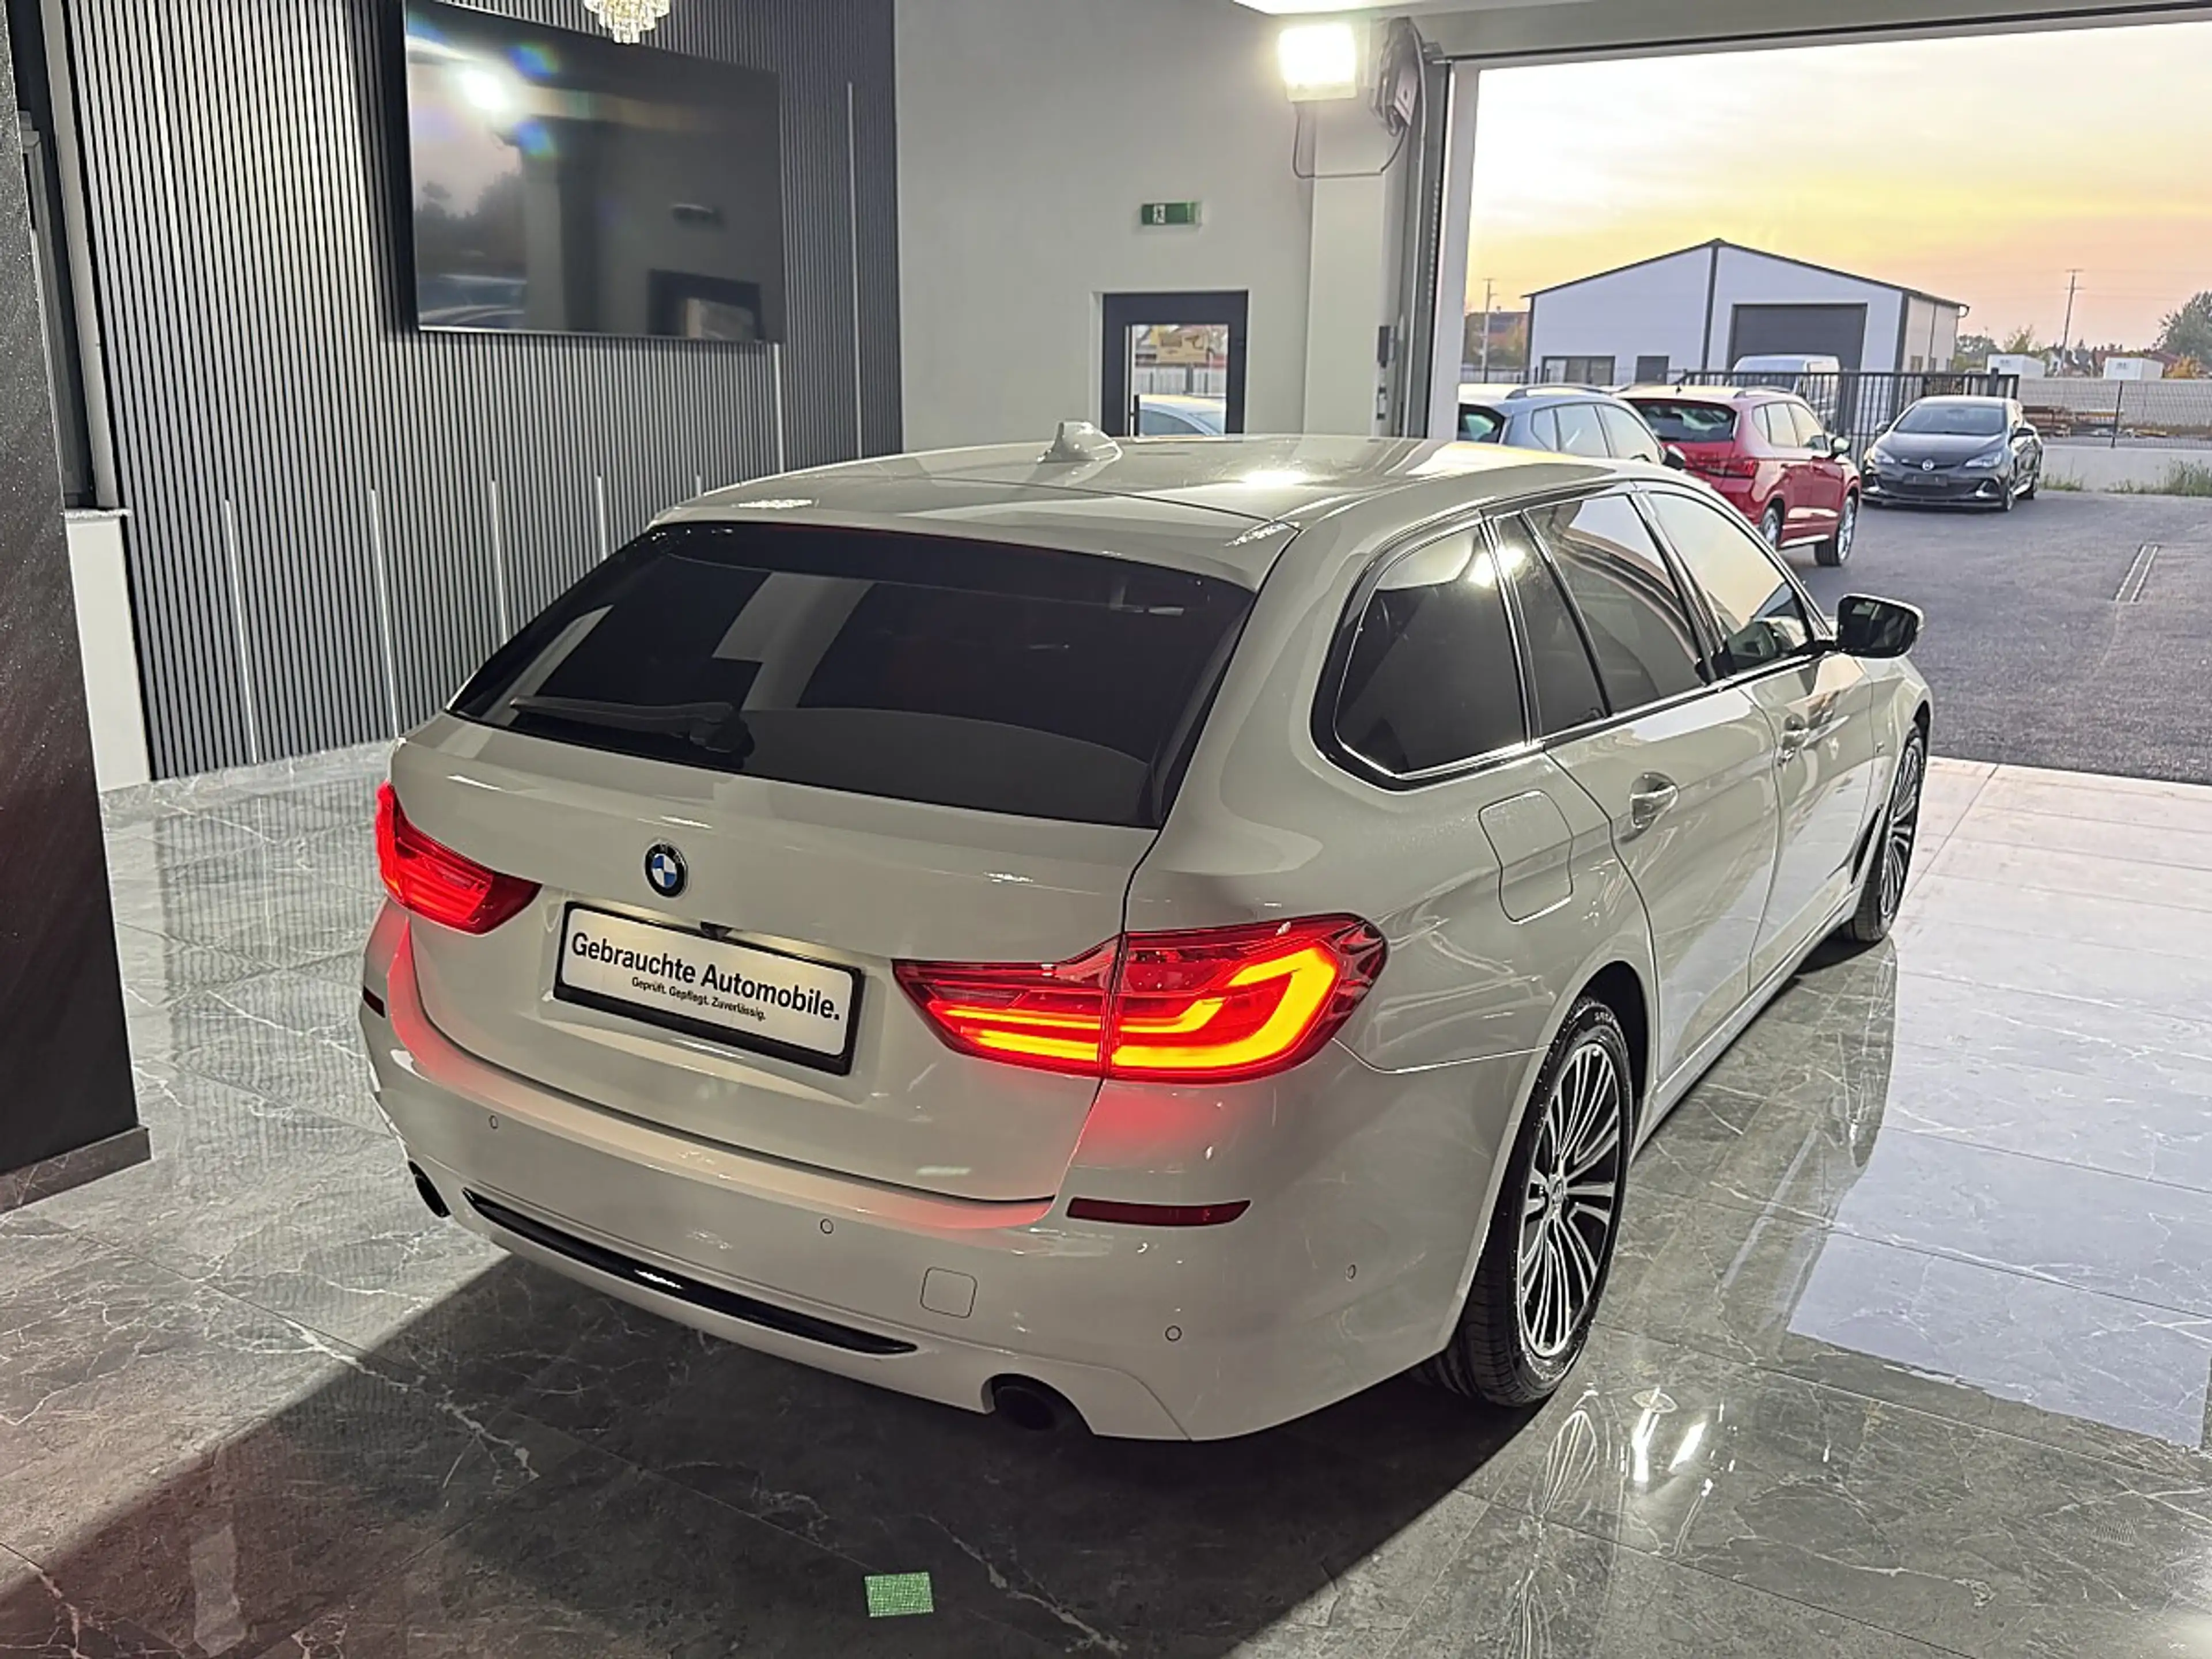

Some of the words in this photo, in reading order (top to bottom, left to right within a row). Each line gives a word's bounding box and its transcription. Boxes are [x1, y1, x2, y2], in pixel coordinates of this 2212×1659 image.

[572, 932, 695, 983] Gebrauchte
[700, 964, 839, 1020] Automobile.
[632, 977, 666, 994] Geprüft.
[669, 986, 709, 1005] Gepflegt.
